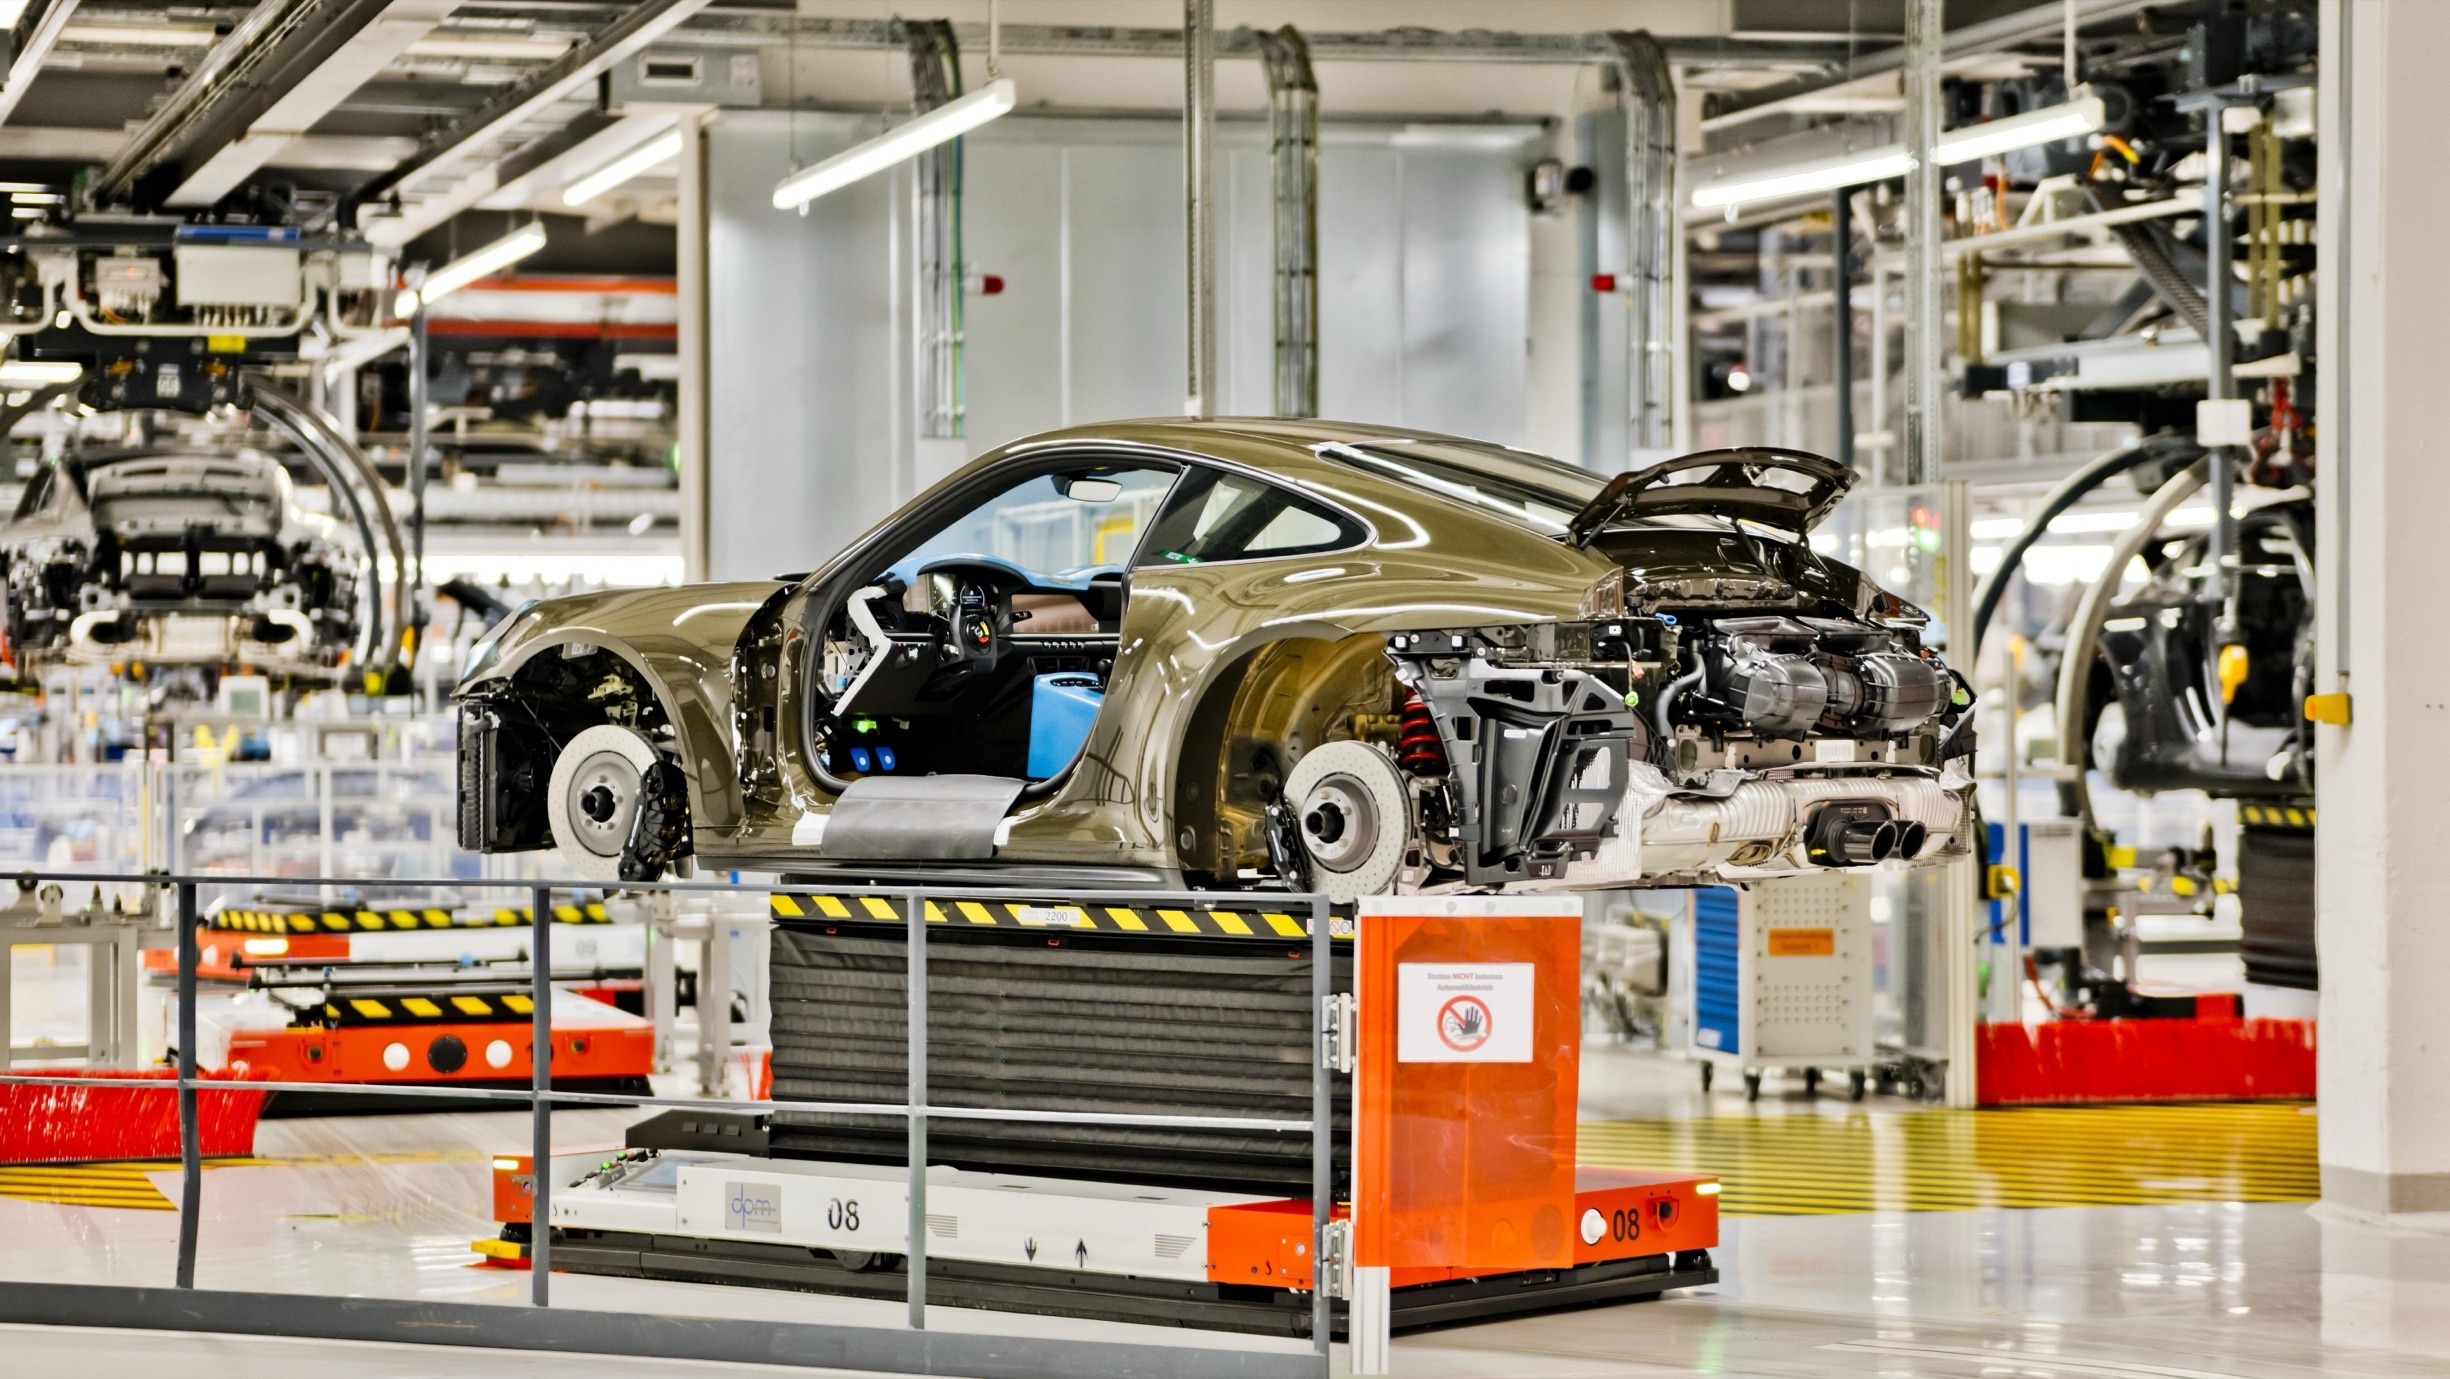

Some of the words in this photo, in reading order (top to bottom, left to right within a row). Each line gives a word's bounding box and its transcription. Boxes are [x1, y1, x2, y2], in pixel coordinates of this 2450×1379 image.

[1045, 911, 1069, 922] 2200
[1452, 972, 1474, 980] NICHT
[827, 1198, 860, 1231] 08
[1613, 1208, 1640, 1242] 08
